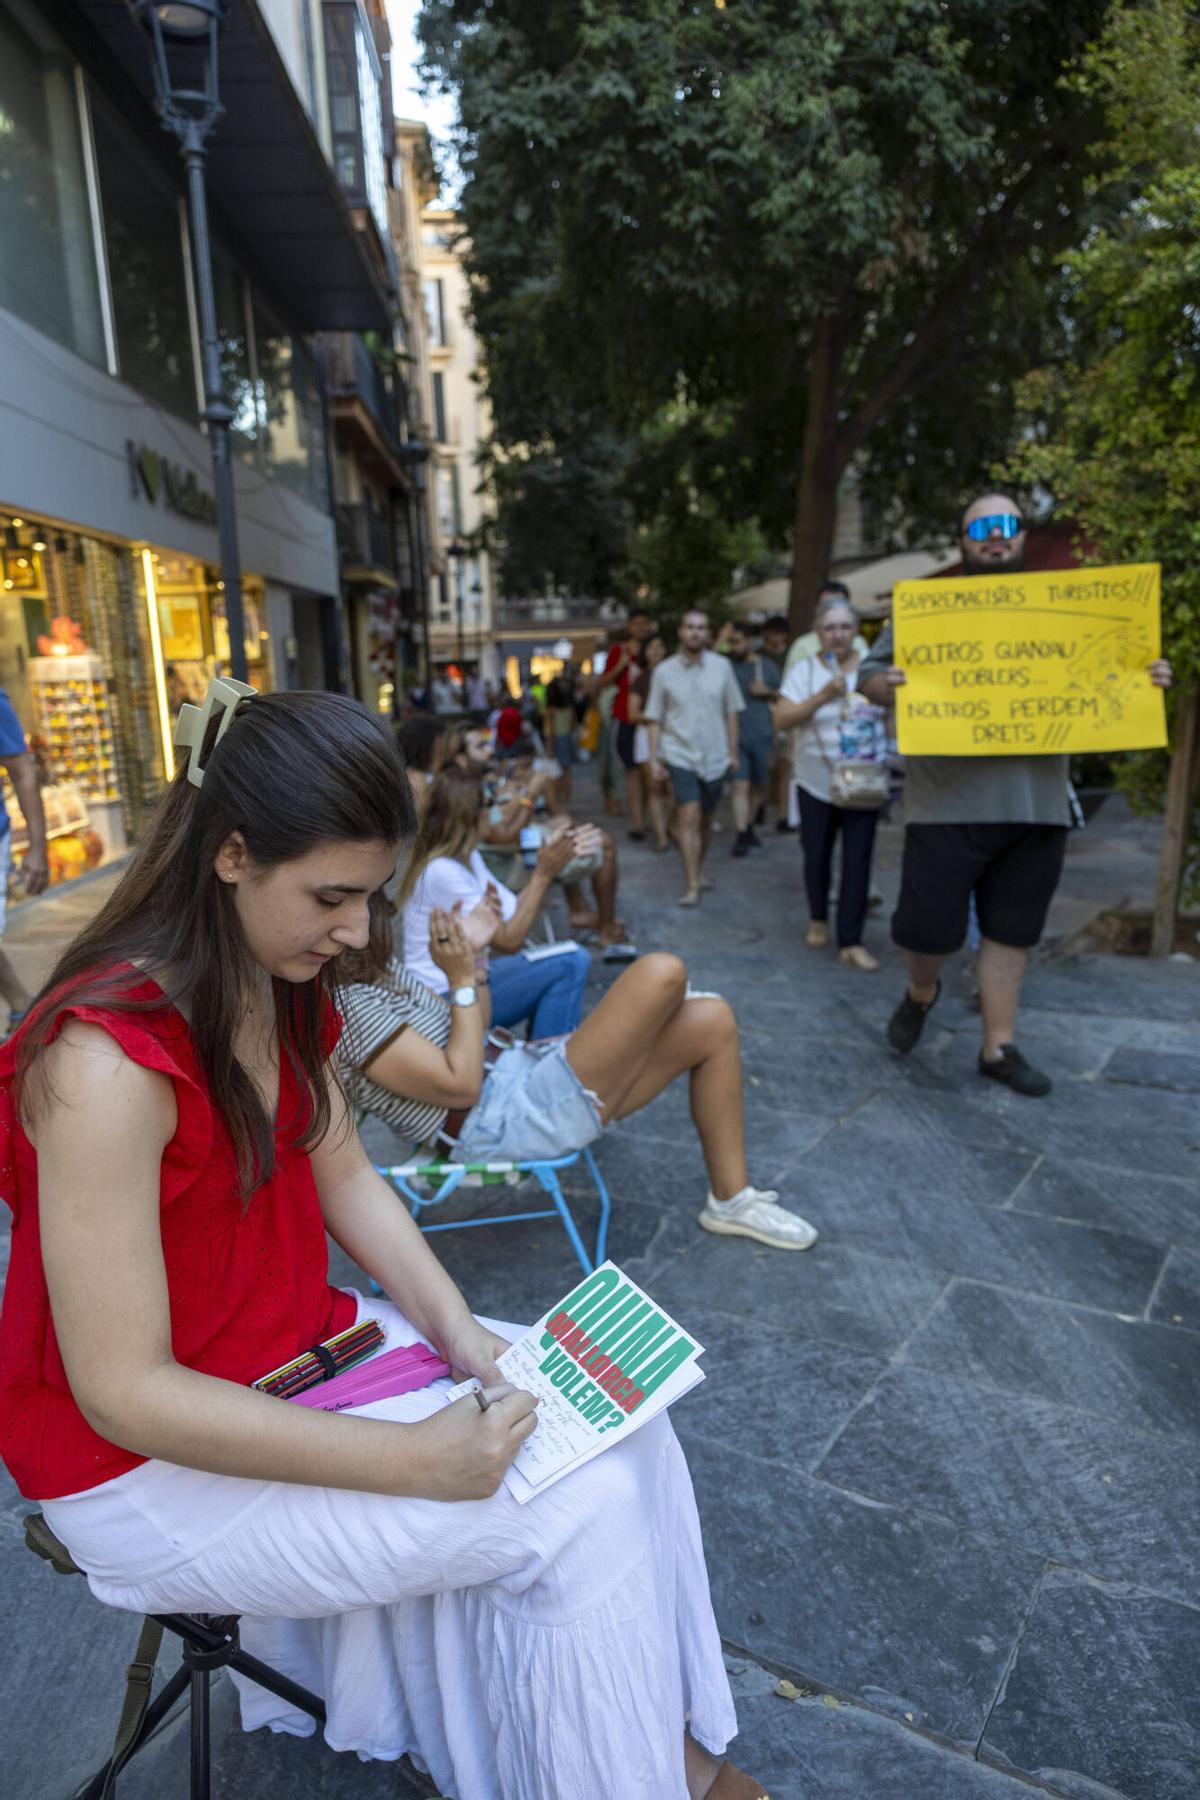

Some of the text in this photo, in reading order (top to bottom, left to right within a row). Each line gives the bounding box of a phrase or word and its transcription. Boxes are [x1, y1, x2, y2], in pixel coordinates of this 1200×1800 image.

[901, 640, 984, 666] VOLTROS
[907, 697, 1099, 720] NOLTROS PERDEM
[538, 1346, 626, 1434] VOLEM?
[544, 1311, 647, 1416] MALLORCA
